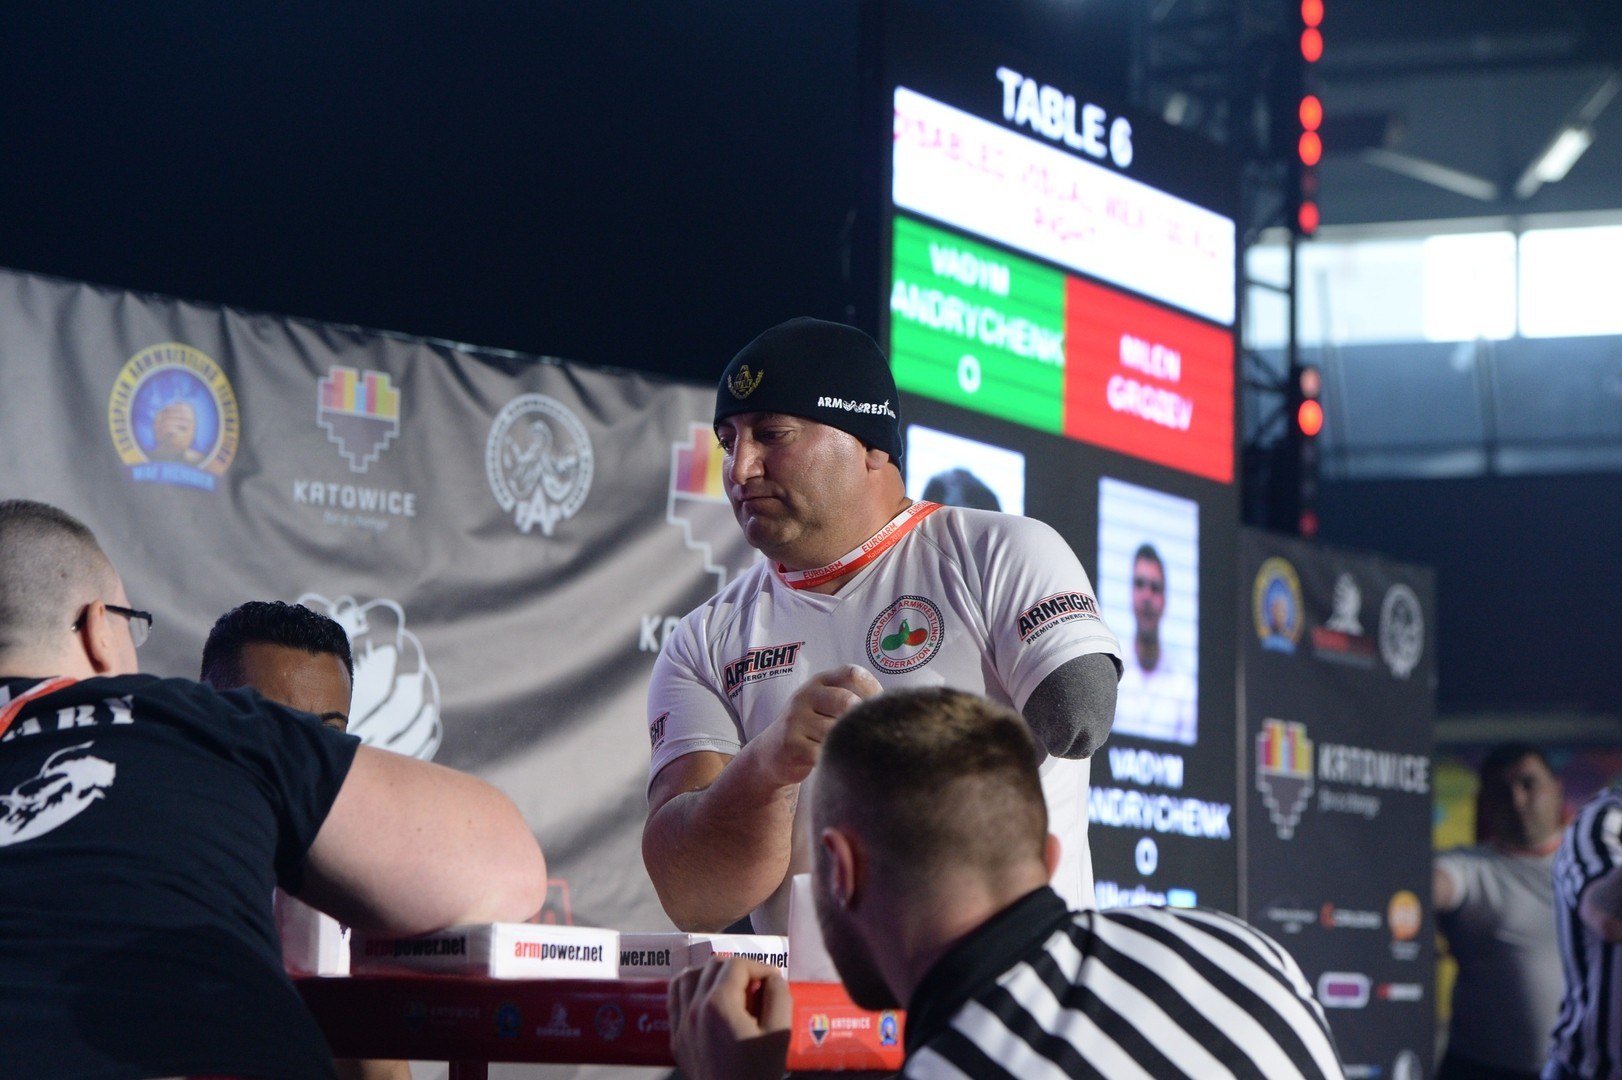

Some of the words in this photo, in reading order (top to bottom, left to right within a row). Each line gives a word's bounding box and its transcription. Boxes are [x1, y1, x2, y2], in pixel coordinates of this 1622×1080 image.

[996, 65, 1107, 159] TABLE
[1110, 116, 1133, 168] 6
[293, 480, 417, 517] KATOWICE
[860, 522, 898, 553] EUROARM
[802, 560, 844, 579] EUROARM
[872, 607, 898, 654] BULGARIAN
[897, 600, 939, 642] ARMWRESTLING
[1018, 593, 1097, 637] ARMFIGHT
[1026, 620, 1060, 645] PREMIUM
[1060, 613, 1086, 623] ENERGY
[725, 644, 799, 690] ARFIGHT
[769, 667, 794, 677] DRINK
[880, 647, 931, 669] FEDERATION
[514, 940, 604, 962] armpower.net
[620, 949, 671, 967] wer.net
